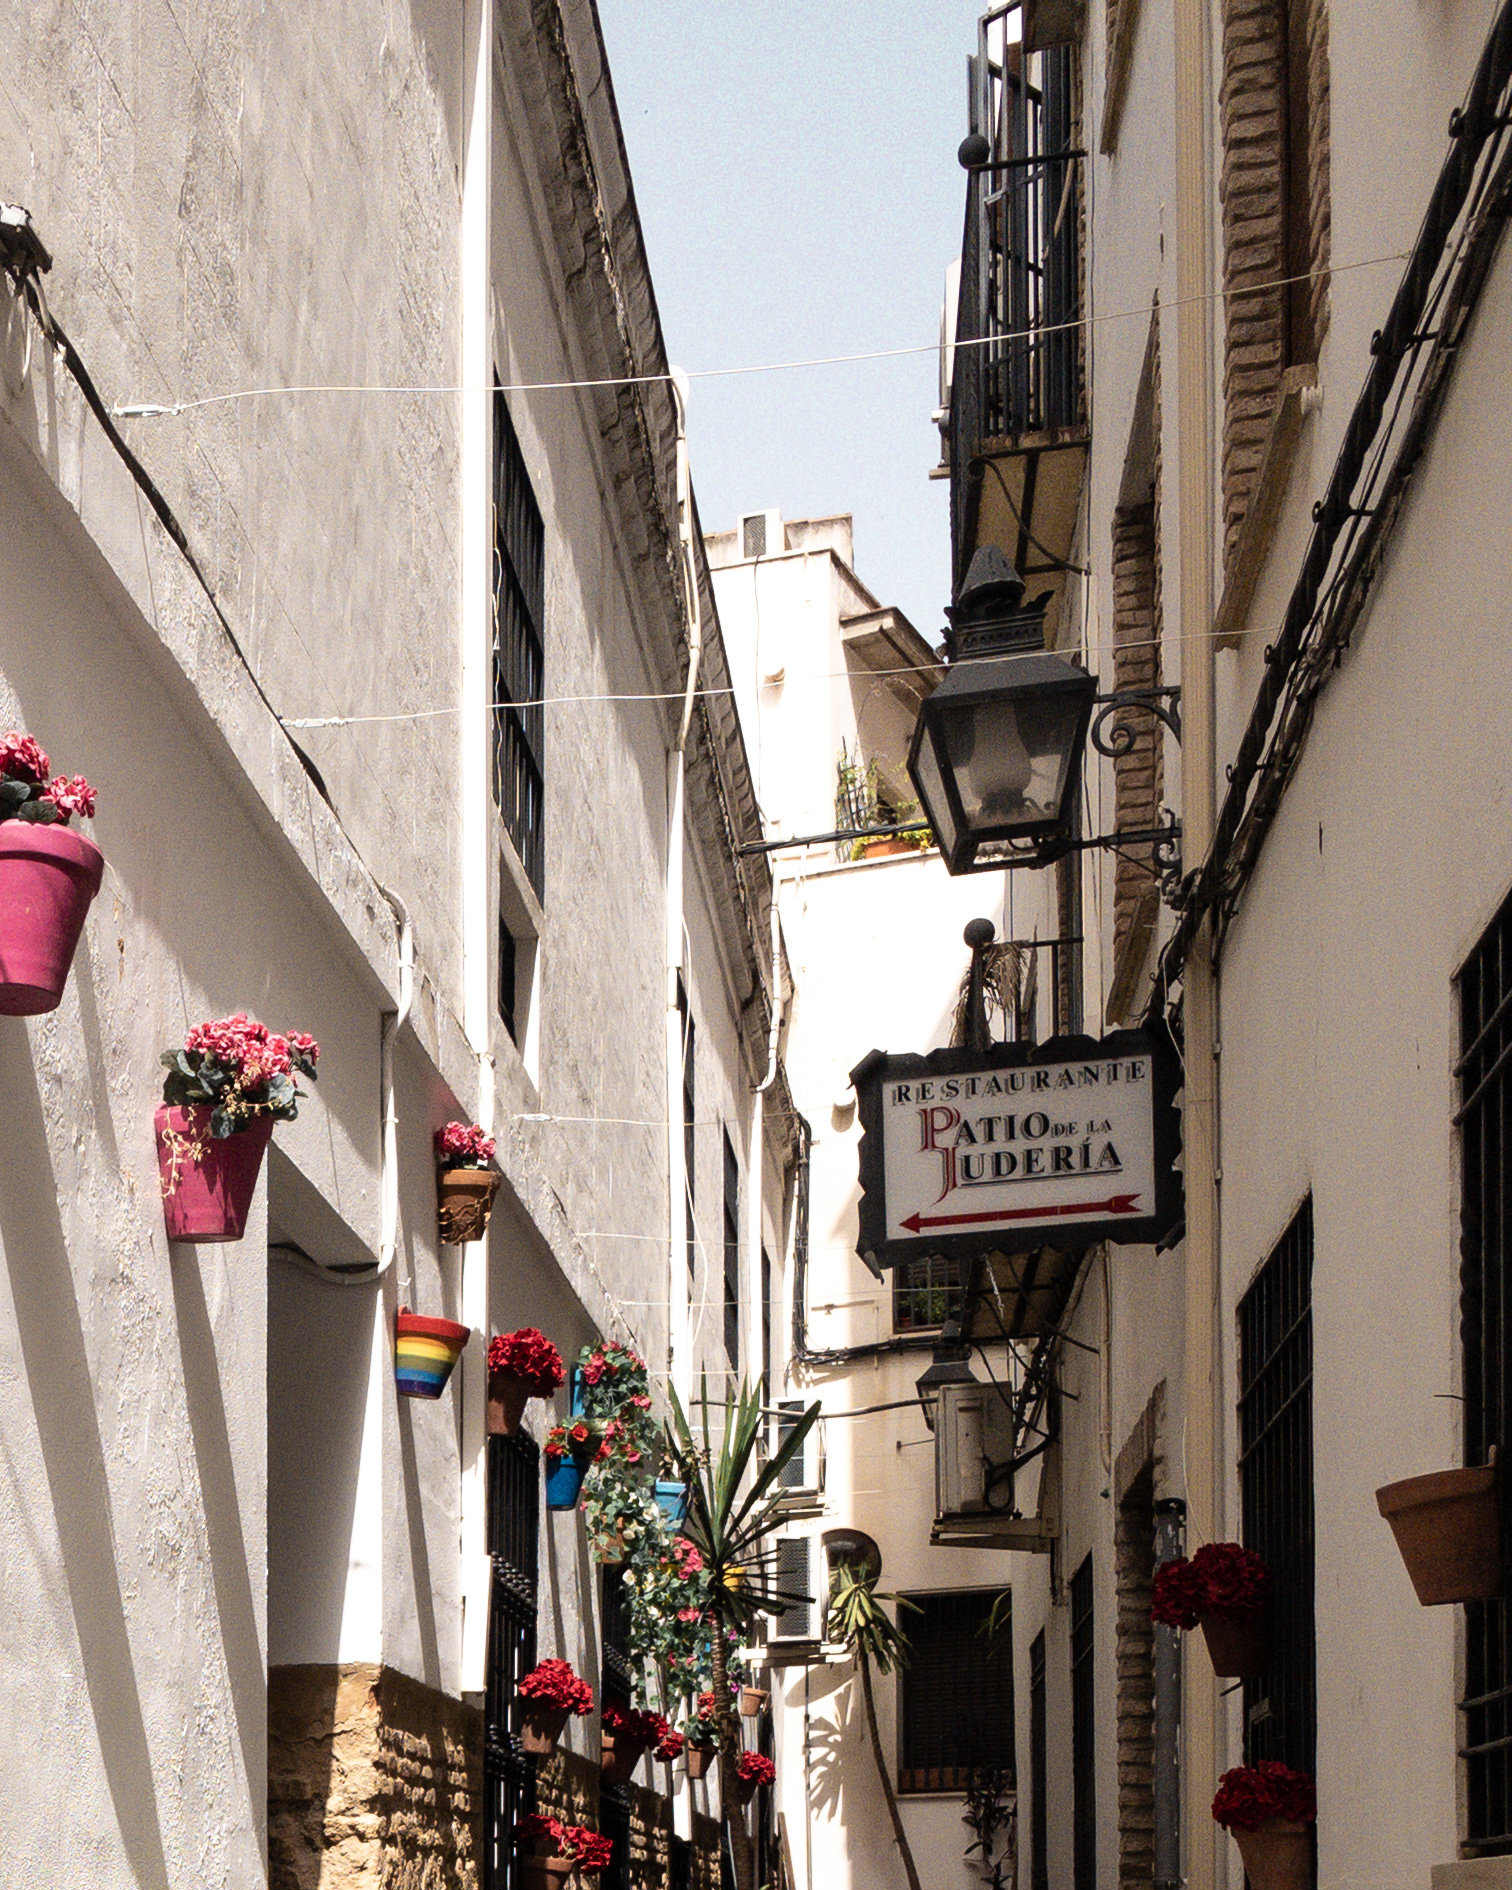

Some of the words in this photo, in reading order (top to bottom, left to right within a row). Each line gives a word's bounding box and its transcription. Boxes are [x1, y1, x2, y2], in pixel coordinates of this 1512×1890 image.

[893, 1060, 1147, 1105] RESTAURANTE
[919, 1105, 1050, 1152] PATIO
[1052, 1121, 1079, 1138] DE
[1088, 1118, 1113, 1135] LA
[931, 1137, 1123, 1206] JUDERÍA
